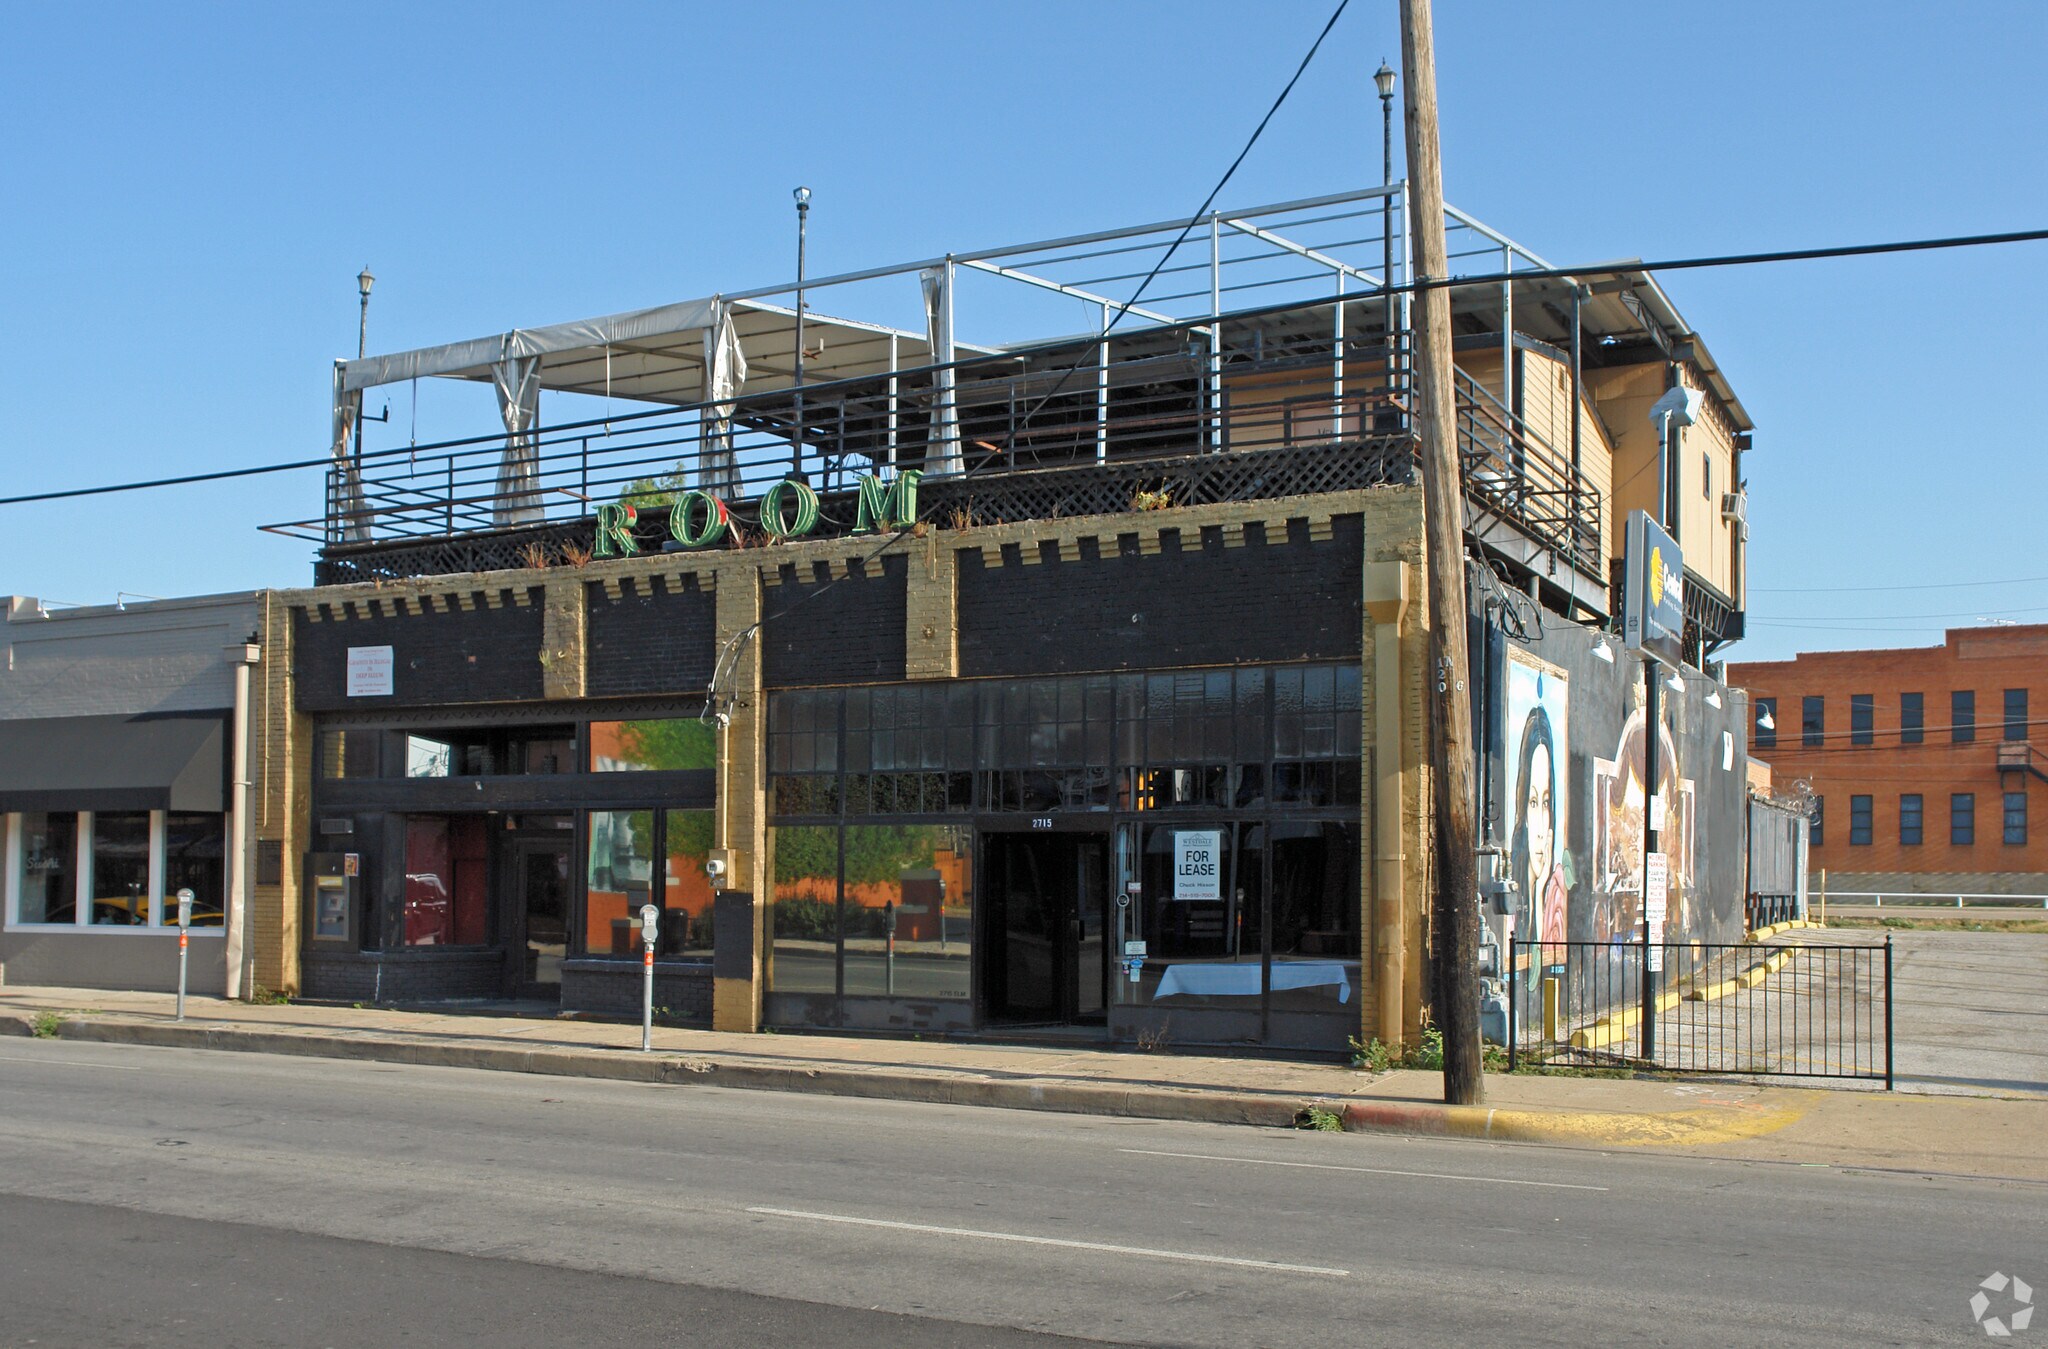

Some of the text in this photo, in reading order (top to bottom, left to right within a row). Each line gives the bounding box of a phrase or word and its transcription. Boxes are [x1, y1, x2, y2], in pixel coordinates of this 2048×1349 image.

[592, 469, 924, 558] ROOM
[1032, 818, 1052, 828] 2715
[1186, 850, 1209, 862] FOR
[1179, 864, 1215, 876] LEASE
